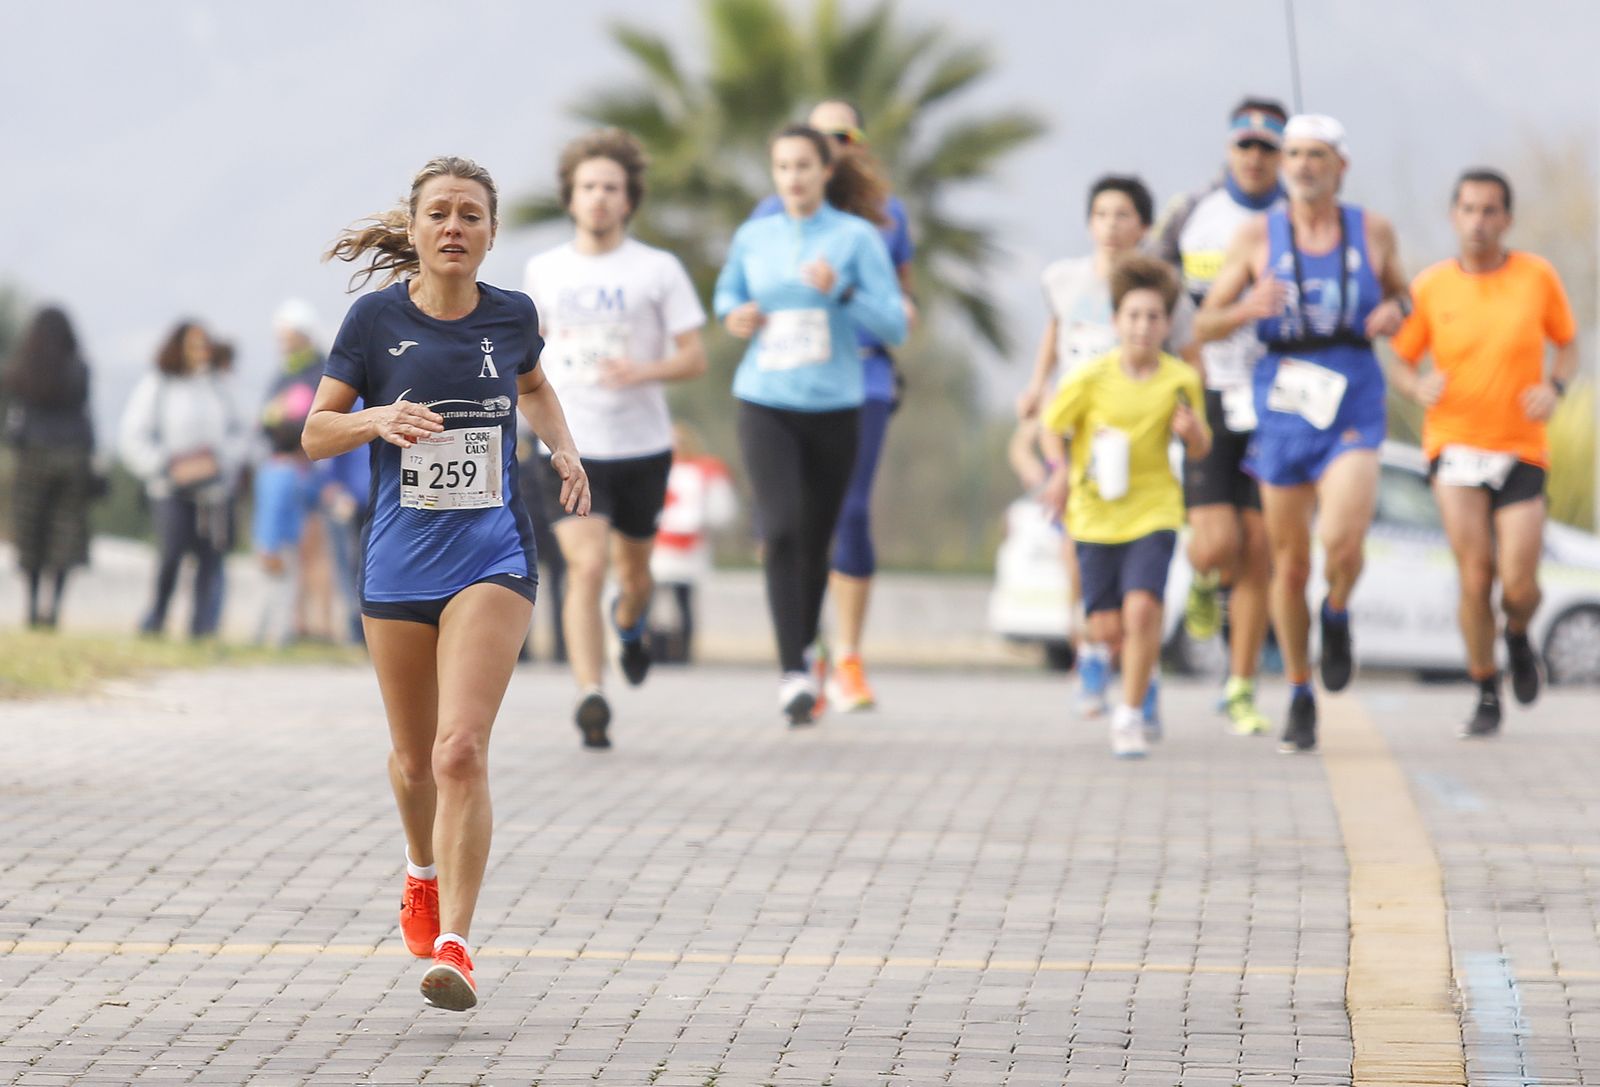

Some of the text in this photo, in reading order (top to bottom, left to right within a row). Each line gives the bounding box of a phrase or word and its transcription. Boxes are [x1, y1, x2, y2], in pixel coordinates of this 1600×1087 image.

[478, 355, 499, 378] A
[439, 411, 468, 419] TLETISMO
[409, 455, 424, 465] 172
[429, 460, 477, 489] 259
